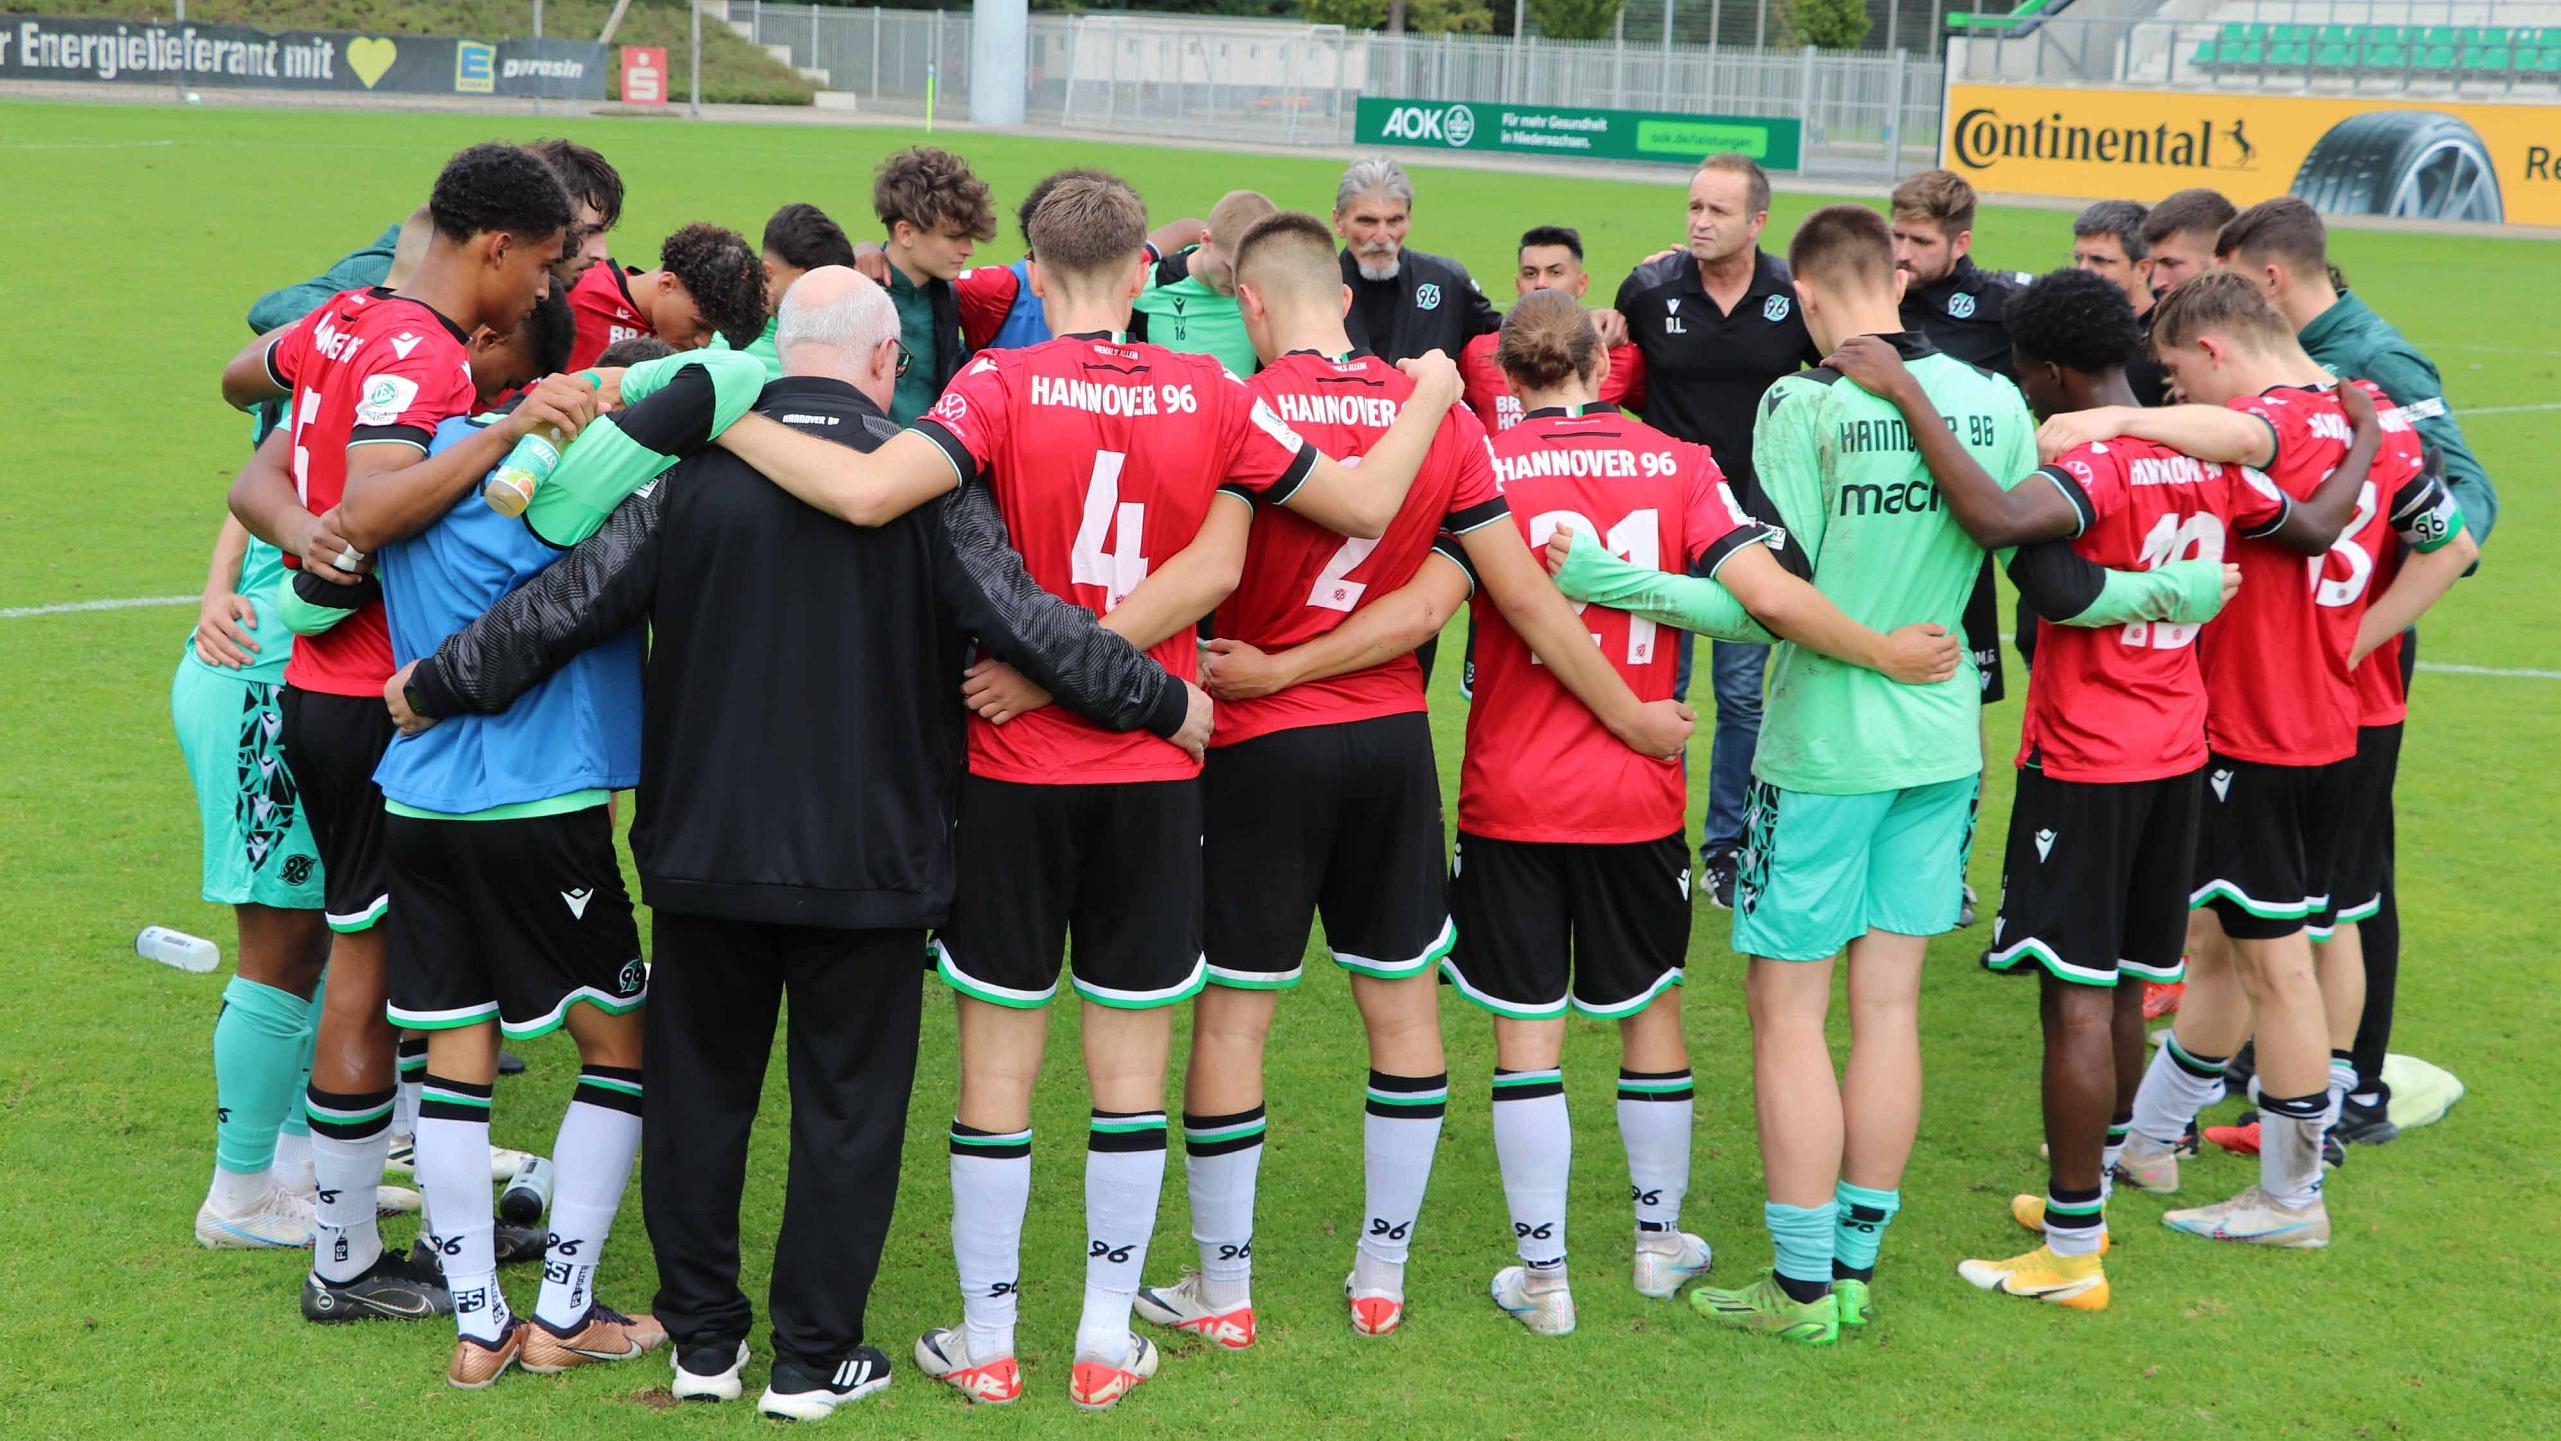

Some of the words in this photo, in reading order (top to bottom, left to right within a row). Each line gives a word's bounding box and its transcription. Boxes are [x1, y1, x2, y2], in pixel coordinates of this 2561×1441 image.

[20, 22, 279, 80] Energielieferant
[285, 37, 335, 79] mit
[1382, 107, 1443, 140] AOK
[1502, 112, 1519, 127] Für
[1520, 115, 1547, 128] mehr
[1548, 115, 1608, 132] Gesundheit
[1501, 129, 1512, 144] in
[1953, 108, 2213, 169] Continental
[1416, 287, 1440, 308] 96
[1765, 296, 1789, 319] 96
[1949, 293, 1974, 317] 96
[1175, 326, 1186, 341] 16
[1031, 375, 1158, 417] HANNOVER
[1161, 384, 1197, 413] 96
[1277, 394, 1397, 428] HANNOVER
[1498, 450, 1638, 481] HANNOVER
[1641, 452, 1677, 477] 96
[1071, 449, 1149, 614] 4
[2414, 512, 2447, 540] 96
[280, 856, 315, 884] 96
[1632, 1185, 1663, 1205] 96
[1370, 1218, 1411, 1240] 96
[1515, 1222, 1555, 1239] 96
[432, 1235, 465, 1256] 96
[546, 1232, 585, 1256] 96
[1089, 1240, 1136, 1263] 96
[1218, 1239, 1251, 1260] 96
[453, 1288, 485, 1313] FS
